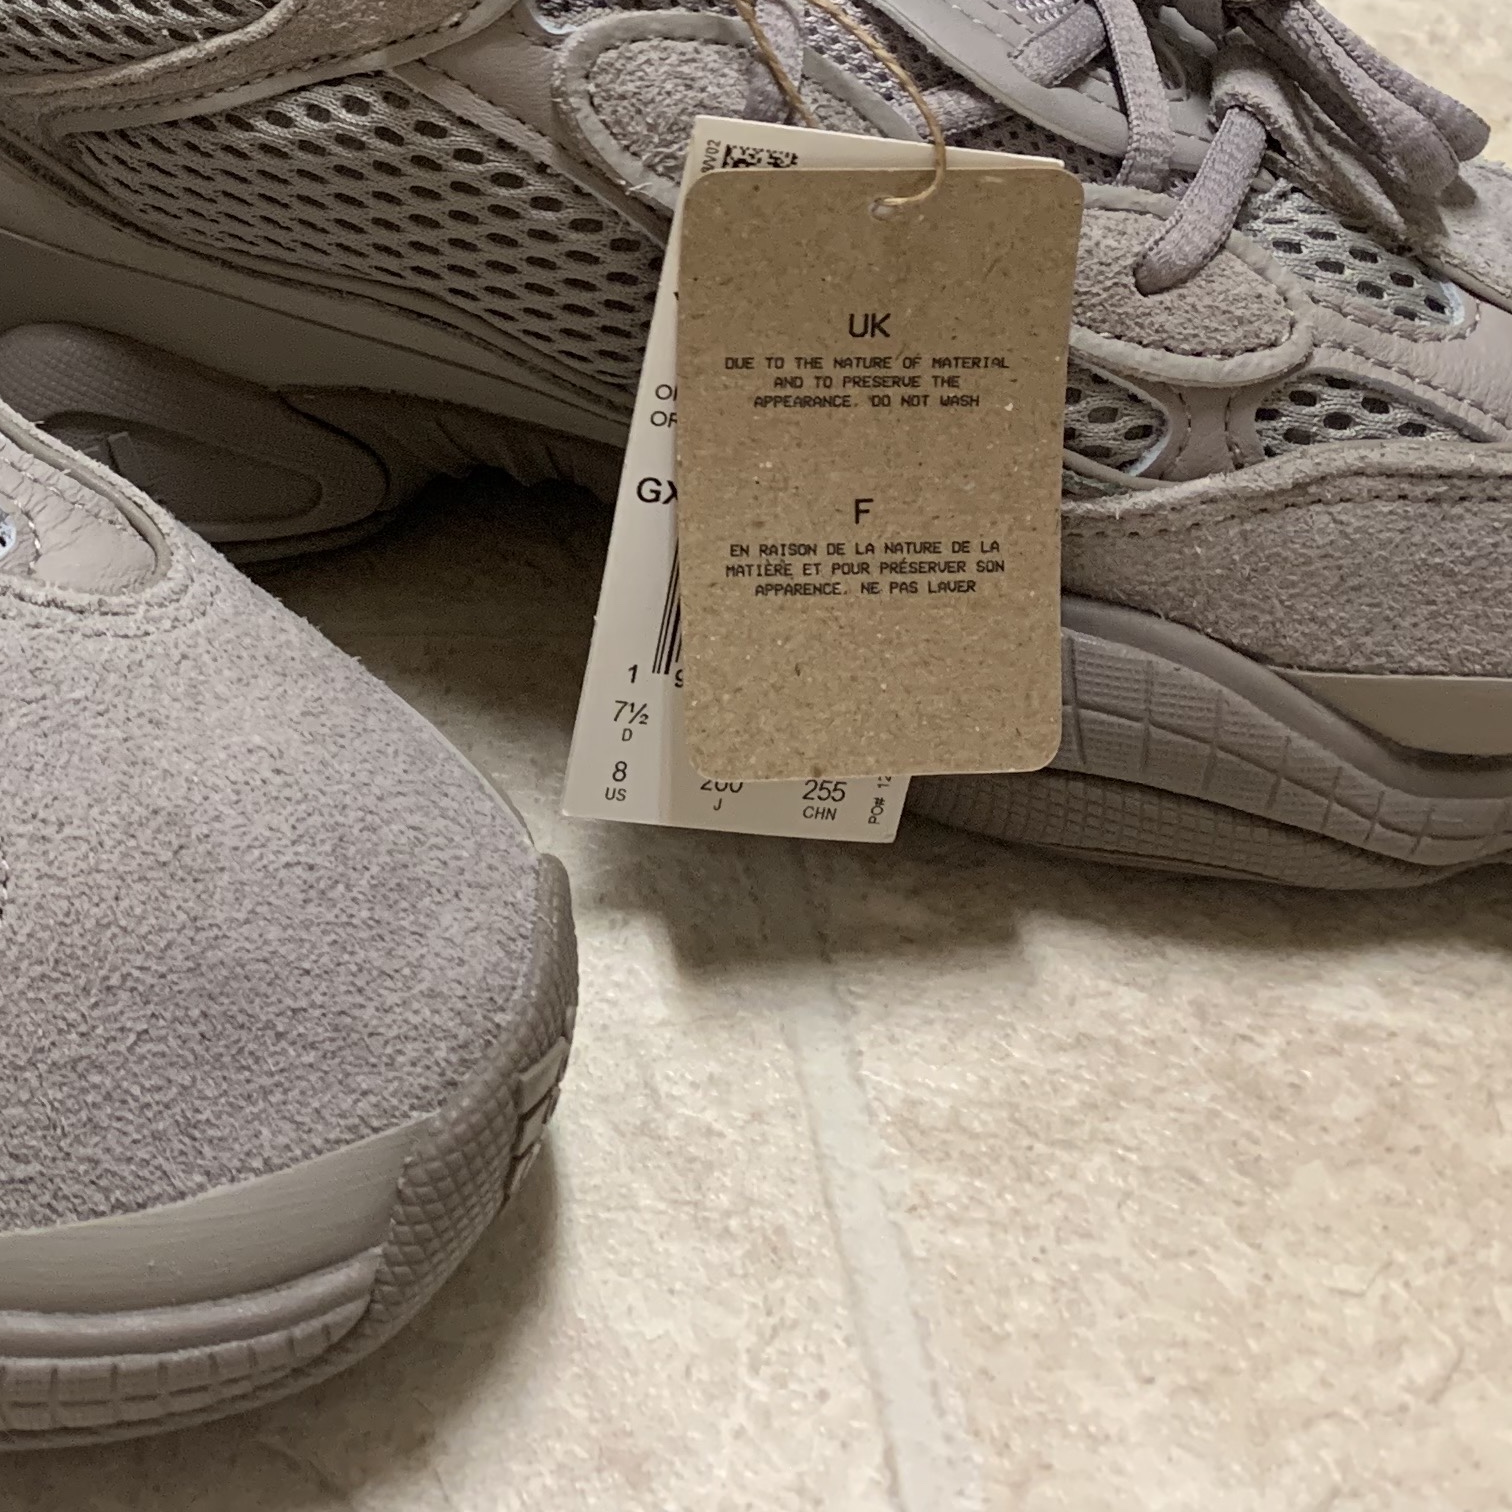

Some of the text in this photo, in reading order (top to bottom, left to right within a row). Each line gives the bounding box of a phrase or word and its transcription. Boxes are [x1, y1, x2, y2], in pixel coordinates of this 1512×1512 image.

[848, 312, 891, 338] UK
[725, 356, 1010, 370] DUE TO THE NATURE OF MATERIAL
[774, 375, 961, 389] AND TO PRESERVE THE
[871, 394, 891, 408] DO
[900, 394, 930, 407] NOT
[939, 395, 980, 407] WASH
[854, 498, 874, 525] F
[730, 540, 1000, 557] EN RAISON DE LA NATURE DE LA
[725, 557, 1005, 578] MATIÈRE ET POUR PRÉSERVER SON
[860, 581, 880, 594] NE
[889, 581, 918, 594] PAS
[928, 579, 977, 593] LAVER
[628, 664, 638, 684] 1
[621, 728, 634, 742] D
[612, 760, 628, 782] 8
[604, 787, 628, 802] US
[802, 779, 848, 802] 255
[713, 798, 723, 812] J
[802, 805, 838, 821] CHN
[867, 796, 886, 825] PO#
